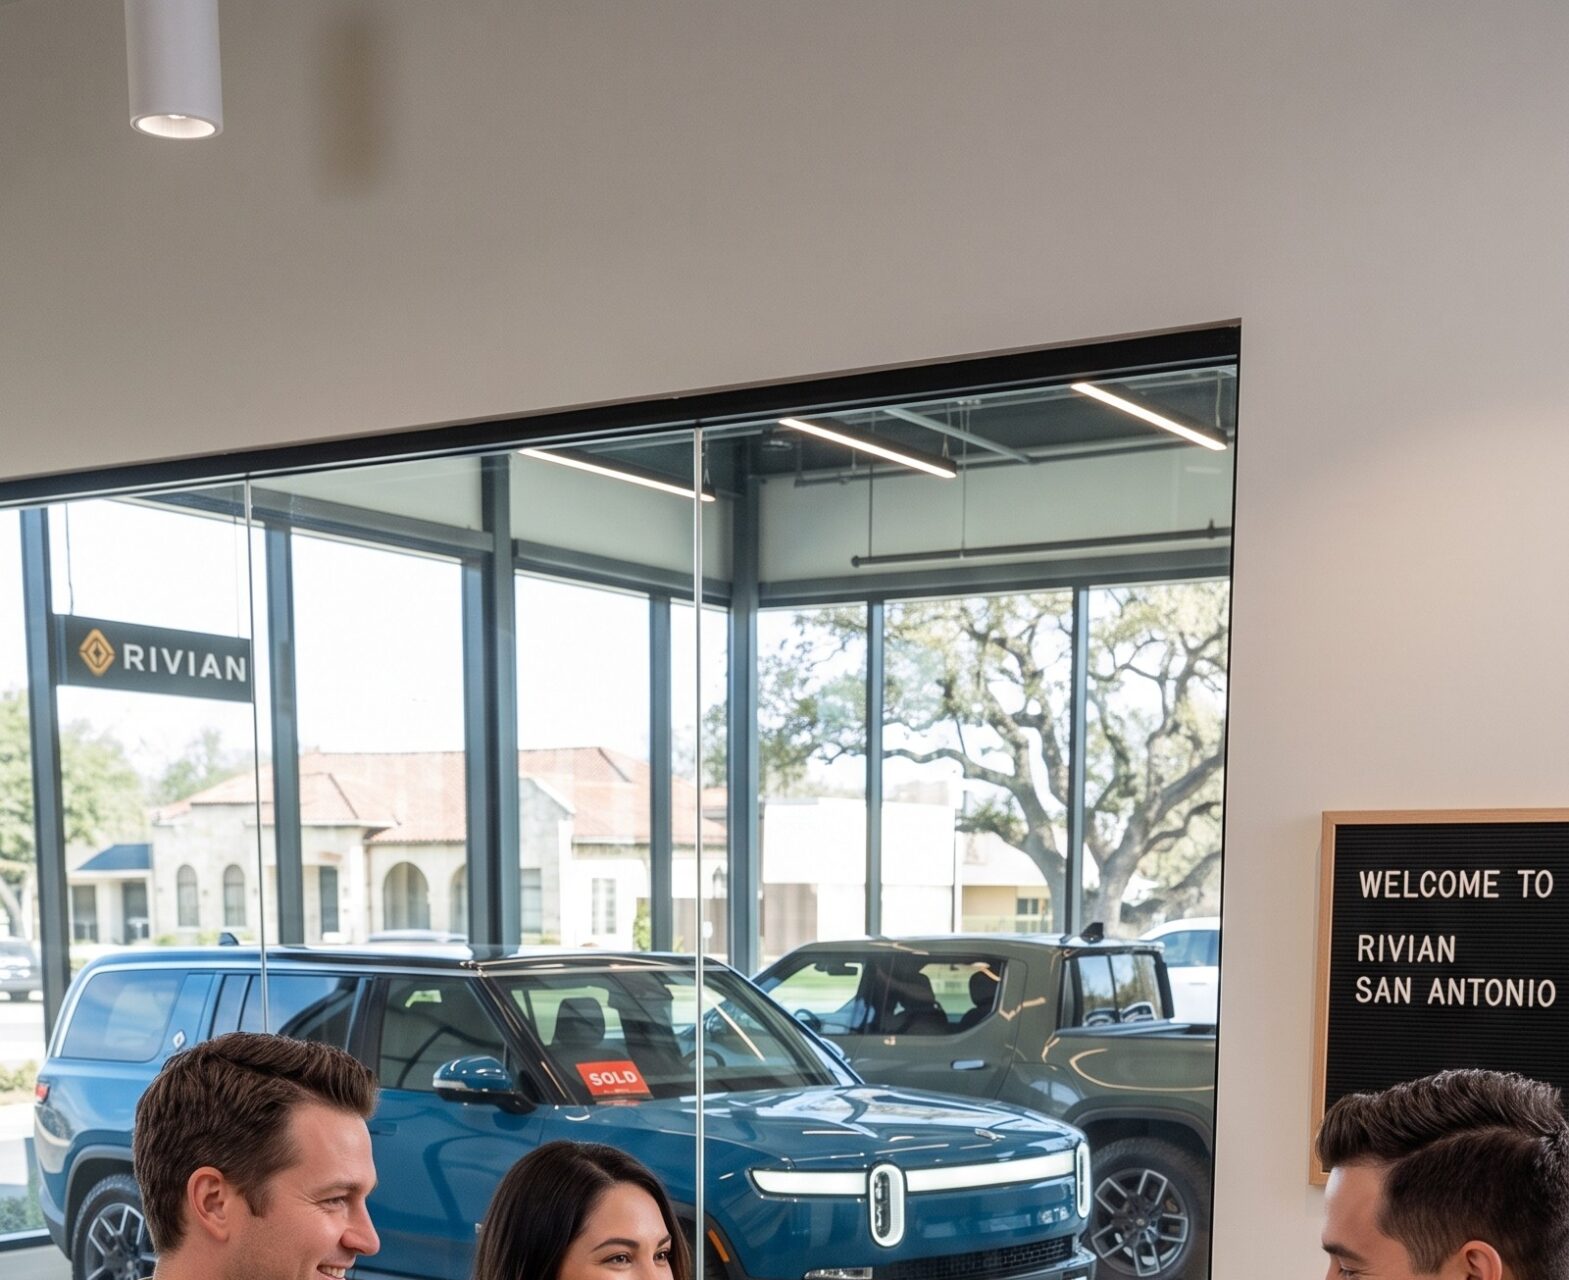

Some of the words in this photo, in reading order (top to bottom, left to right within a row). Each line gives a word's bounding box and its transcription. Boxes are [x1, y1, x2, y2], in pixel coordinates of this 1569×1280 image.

[123, 643, 246, 682] RIVIAN
[1359, 870, 1500, 898] WELCOME
[1517, 869, 1554, 898] TO
[1357, 934, 1456, 963] RIVIAN
[1355, 976, 1412, 1004] SAN
[1427, 977, 1556, 1008] ANTONIO
[588, 1070, 638, 1087] SOLD
